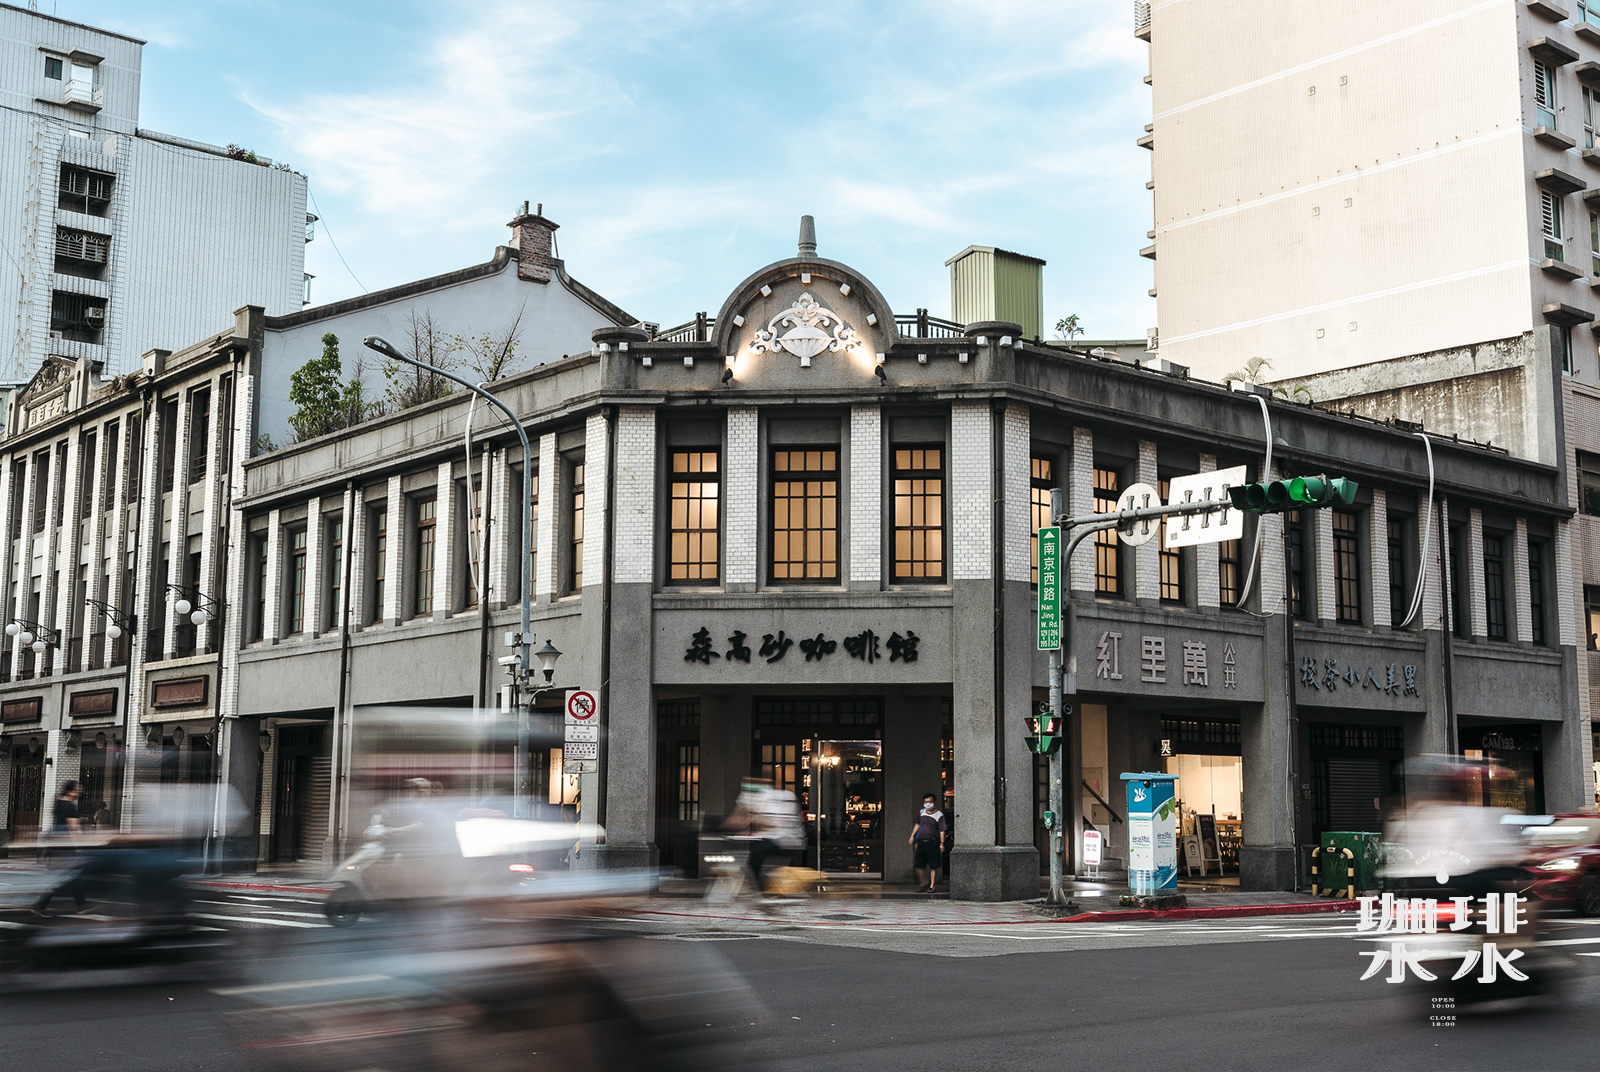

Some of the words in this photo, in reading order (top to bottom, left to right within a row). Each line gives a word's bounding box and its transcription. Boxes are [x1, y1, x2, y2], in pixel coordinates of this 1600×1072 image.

[1043, 542, 1056, 601] 南京西路
[1041, 612, 1054, 620] Jing
[684, 626, 921, 664] 森高砂咖啡館
